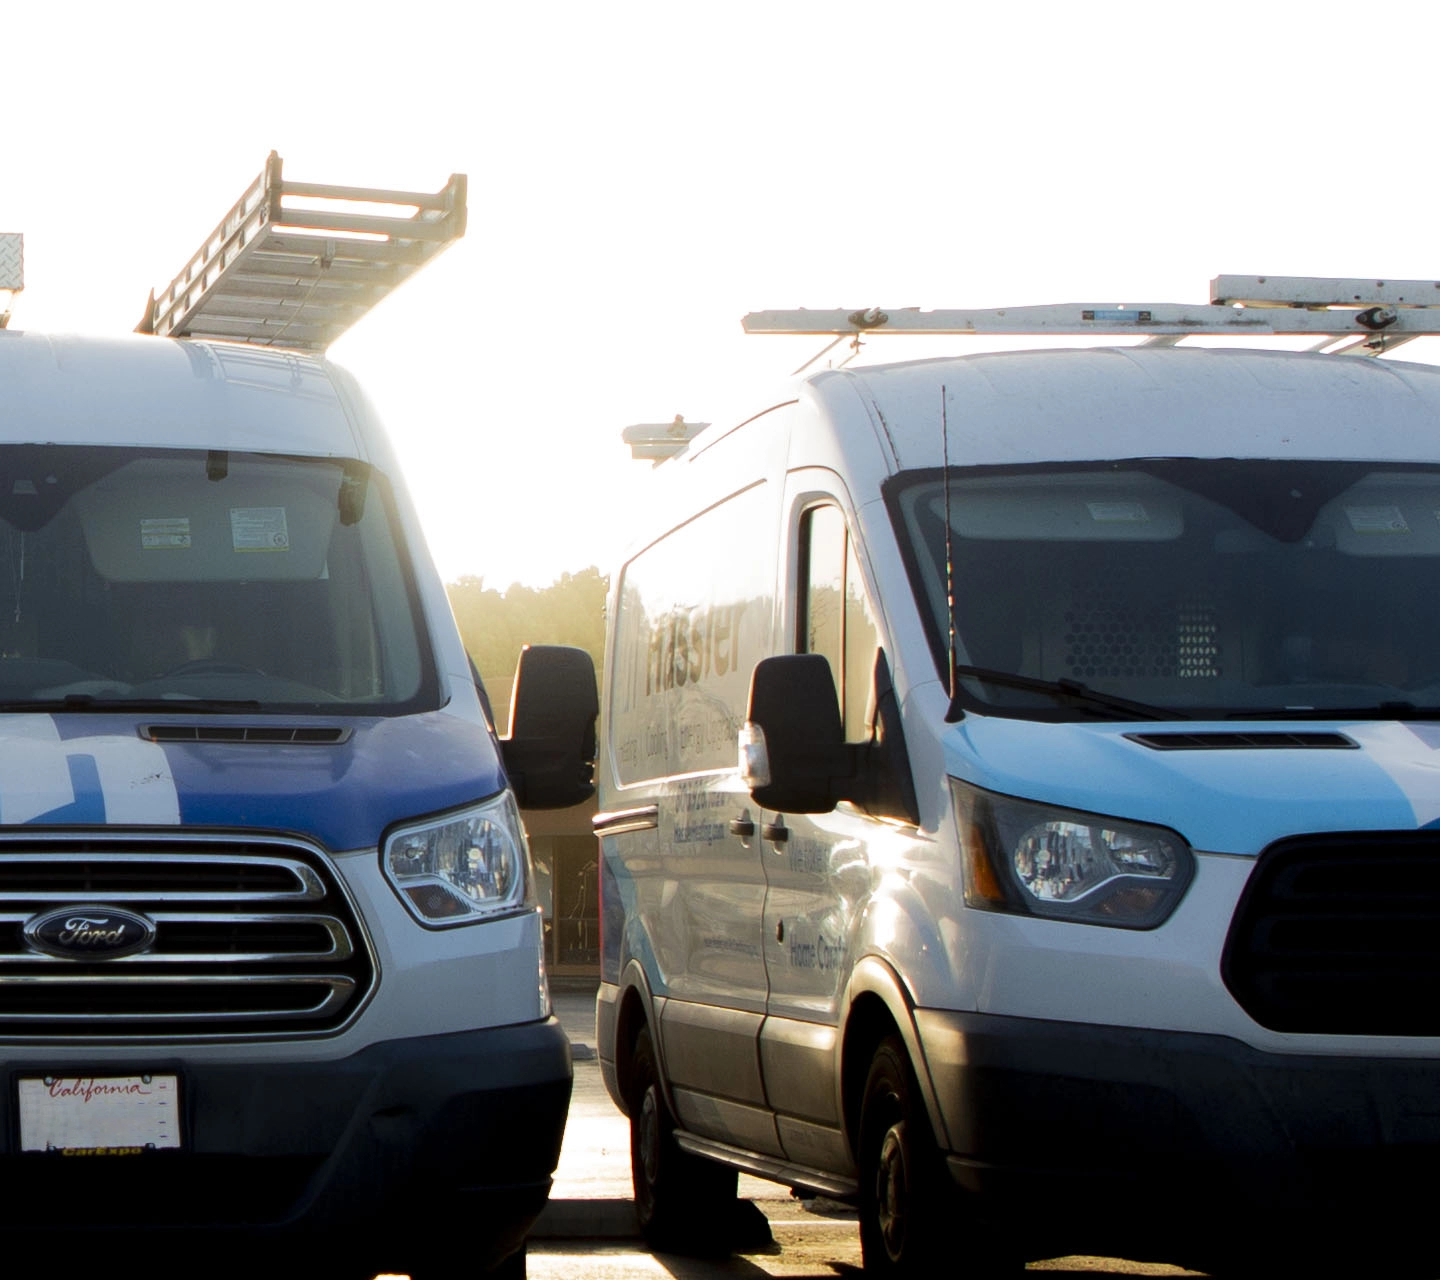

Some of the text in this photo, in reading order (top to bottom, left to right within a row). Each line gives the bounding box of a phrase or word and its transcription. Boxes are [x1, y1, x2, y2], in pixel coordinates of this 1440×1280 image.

[58, 917, 126, 946] Ford
[48, 1078, 152, 1103] California
[62, 1146, 143, 1157] CarExpo
